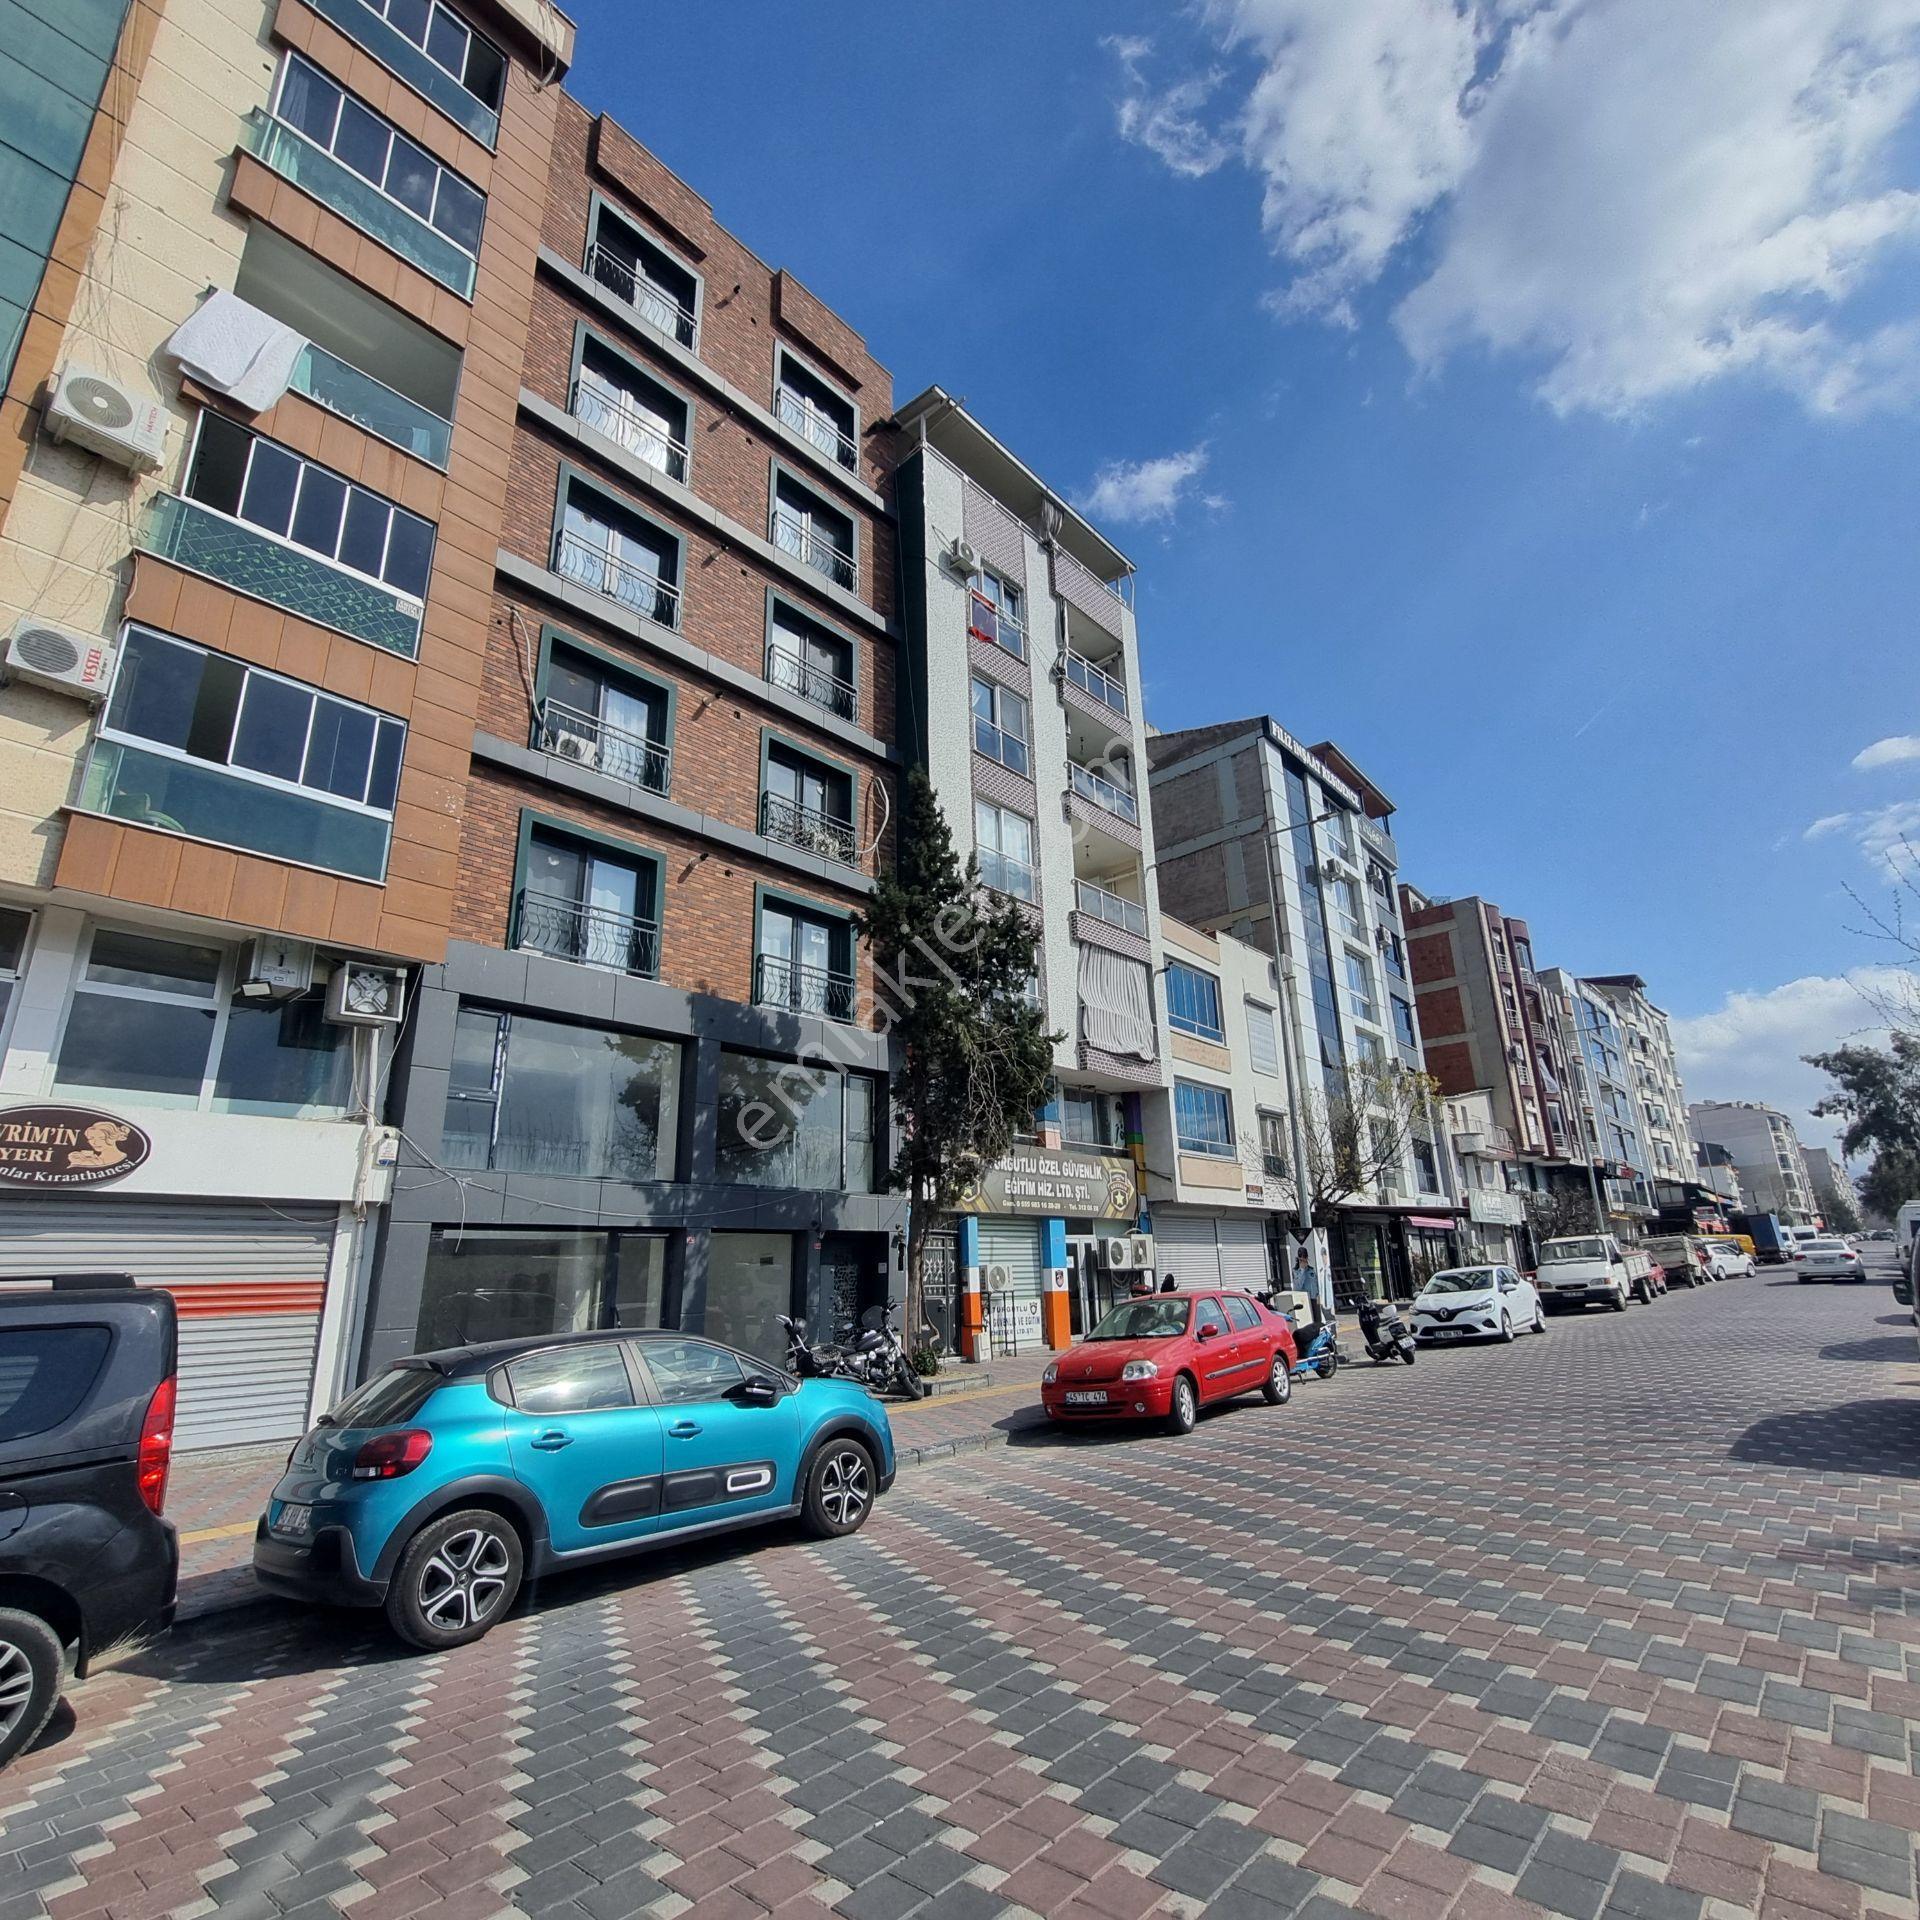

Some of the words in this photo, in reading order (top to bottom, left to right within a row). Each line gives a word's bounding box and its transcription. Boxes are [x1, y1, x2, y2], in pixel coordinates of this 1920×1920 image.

[81, 648, 102, 682] VESTEL
[34, 1158, 136, 1181] Kıraathanesi
[989, 1155, 1037, 1174] URGUTLU
[1039, 1155, 1061, 1175] ÖZEL
[1062, 1159, 1103, 1180] GÜVENLİK
[1004, 1176, 1036, 1196] EĞİTİM
[1037, 1179, 1055, 1198] HİZ.
[1056, 1183, 1074, 1199] LTD.
[1075, 1182, 1091, 1202] ŞTİ.
[992, 1305, 1028, 1313] TURGTLU
